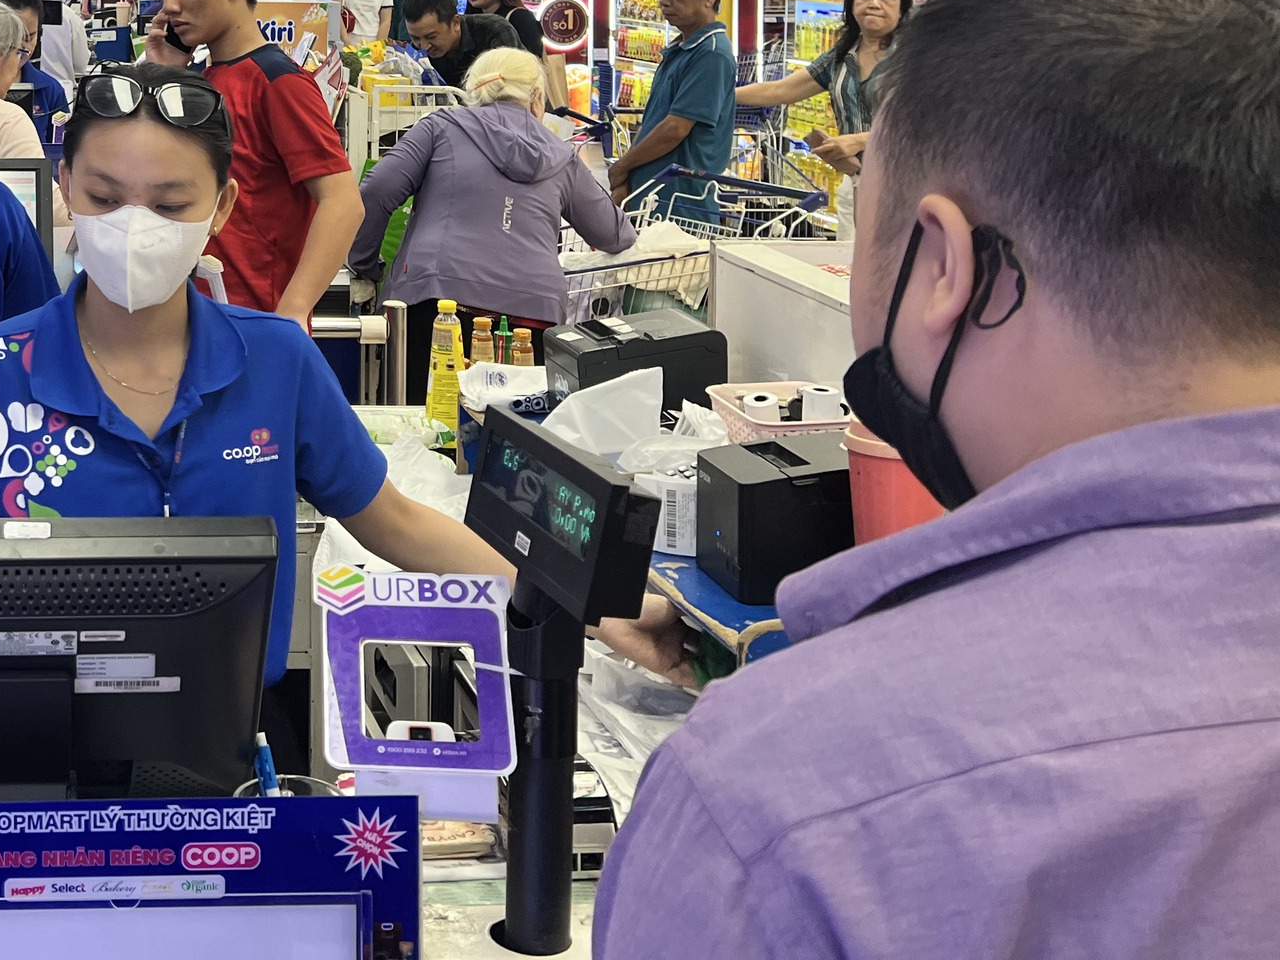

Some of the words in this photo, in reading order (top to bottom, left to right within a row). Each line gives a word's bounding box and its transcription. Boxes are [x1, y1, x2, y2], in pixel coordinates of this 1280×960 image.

[563, 8, 574, 30] 1
[502, 196, 514, 234] ACTIVE
[372, 576, 497, 605] URBOX
[387, 746, 403, 754] 1900
[416, 747, 428, 755] 232
[89, 805, 122, 832] LÝ
[120, 805, 221, 832] THƯỜNG
[222, 803, 276, 833] KIỆT
[426, 829, 476, 842] CAPYB
[41, 846, 106, 868] NHÃN
[109, 845, 176, 866] RIÊNG
[185, 846, 258, 866] COOP
[10, 884, 47, 897] Happy
[51, 883, 87, 893] Select
[91, 880, 137, 898] Bakery
[181, 880, 221, 894] Organic
